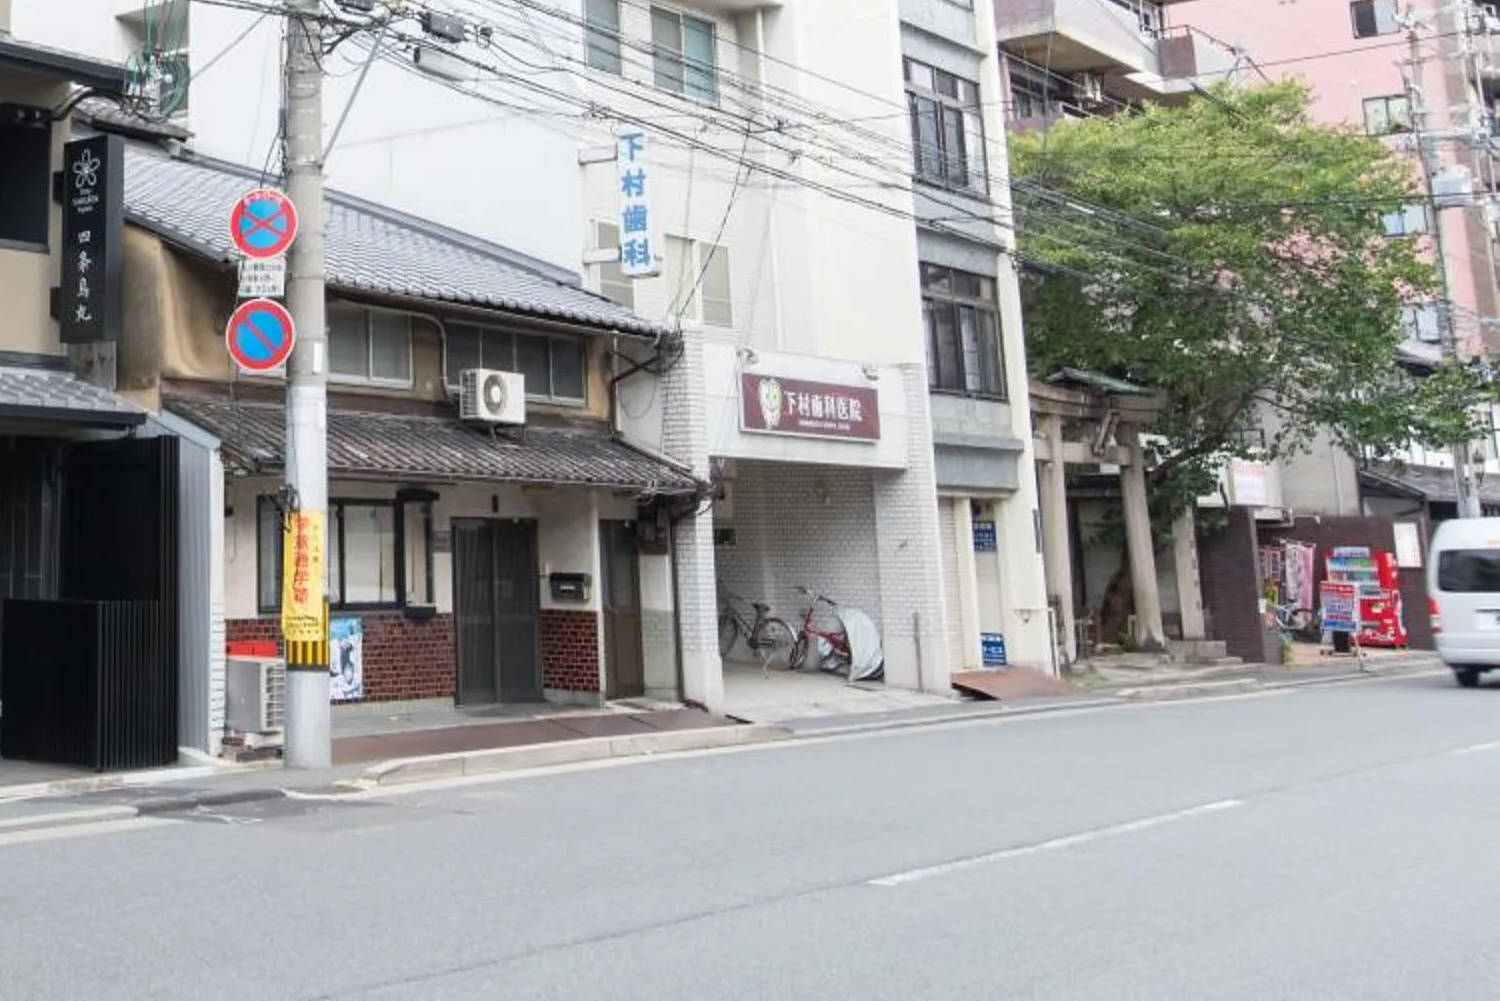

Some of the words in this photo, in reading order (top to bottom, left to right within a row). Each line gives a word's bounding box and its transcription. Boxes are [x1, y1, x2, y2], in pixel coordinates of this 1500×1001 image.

[620, 132, 651, 267] 下村歯科
[783, 390, 863, 422] 下村歯科医院
